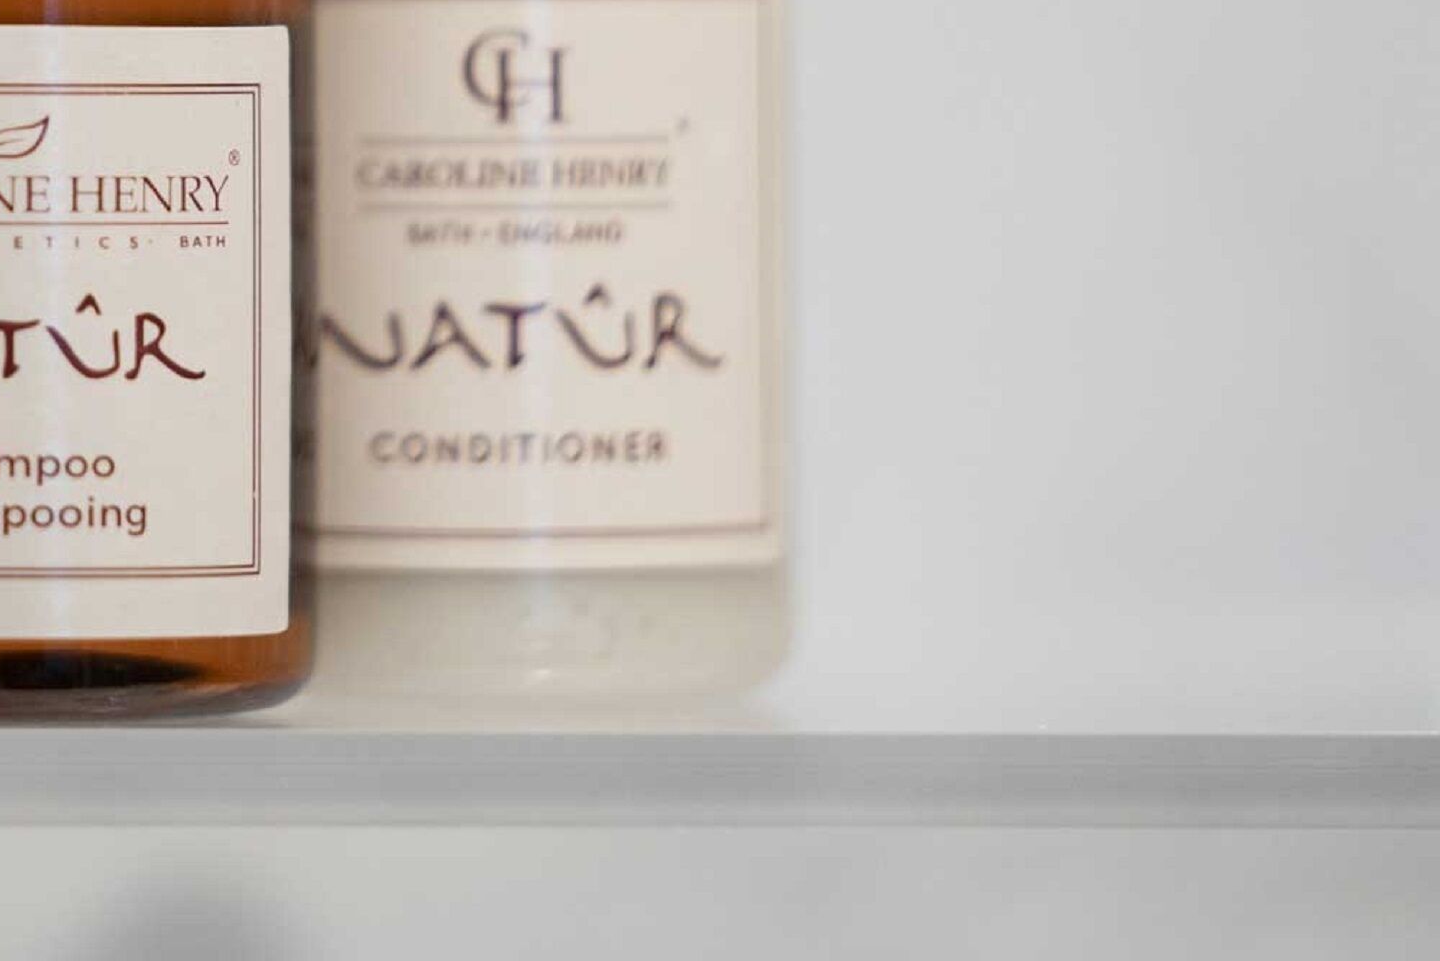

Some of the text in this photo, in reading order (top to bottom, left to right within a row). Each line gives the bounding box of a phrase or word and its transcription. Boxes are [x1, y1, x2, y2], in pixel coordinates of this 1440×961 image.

[358, 158, 670, 189] CAROLINE HENRY
[71, 174, 229, 213] HENRY
[180, 235, 226, 248] BATH
[370, 432, 668, 464] CONDITIONER
